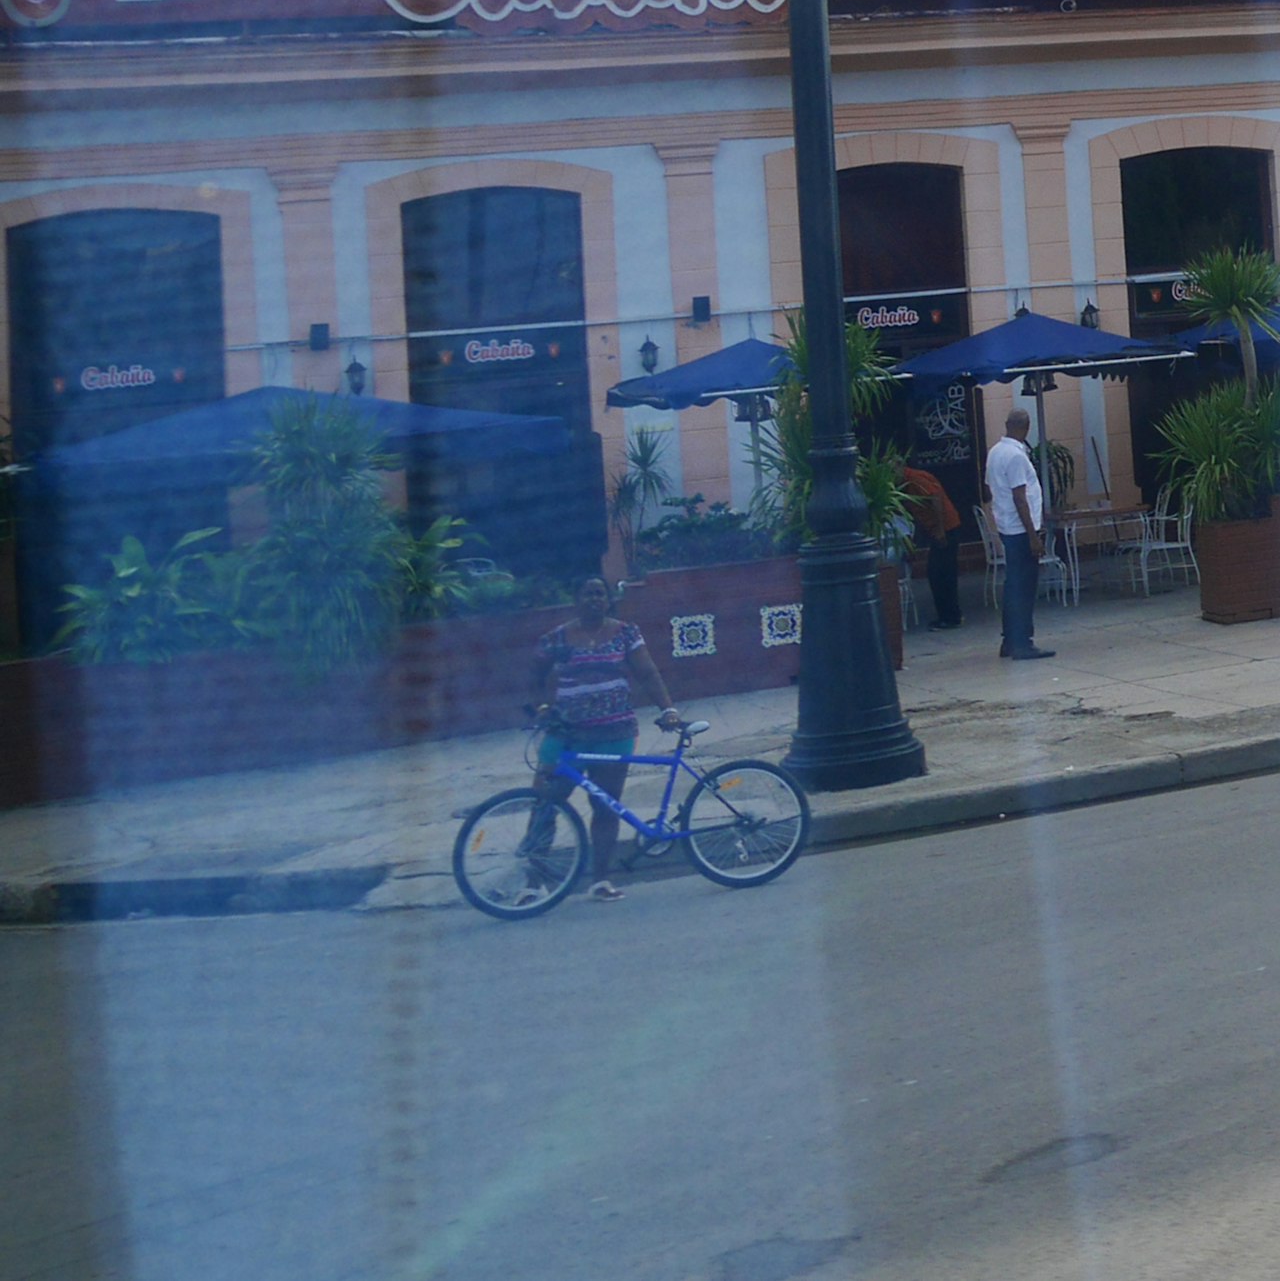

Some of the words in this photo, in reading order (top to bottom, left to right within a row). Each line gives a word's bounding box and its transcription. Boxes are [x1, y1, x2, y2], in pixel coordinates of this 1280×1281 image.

[857, 306, 920, 328] Cabaña
[465, 339, 535, 363] Cabaña
[81, 364, 156, 391] Cabaña
